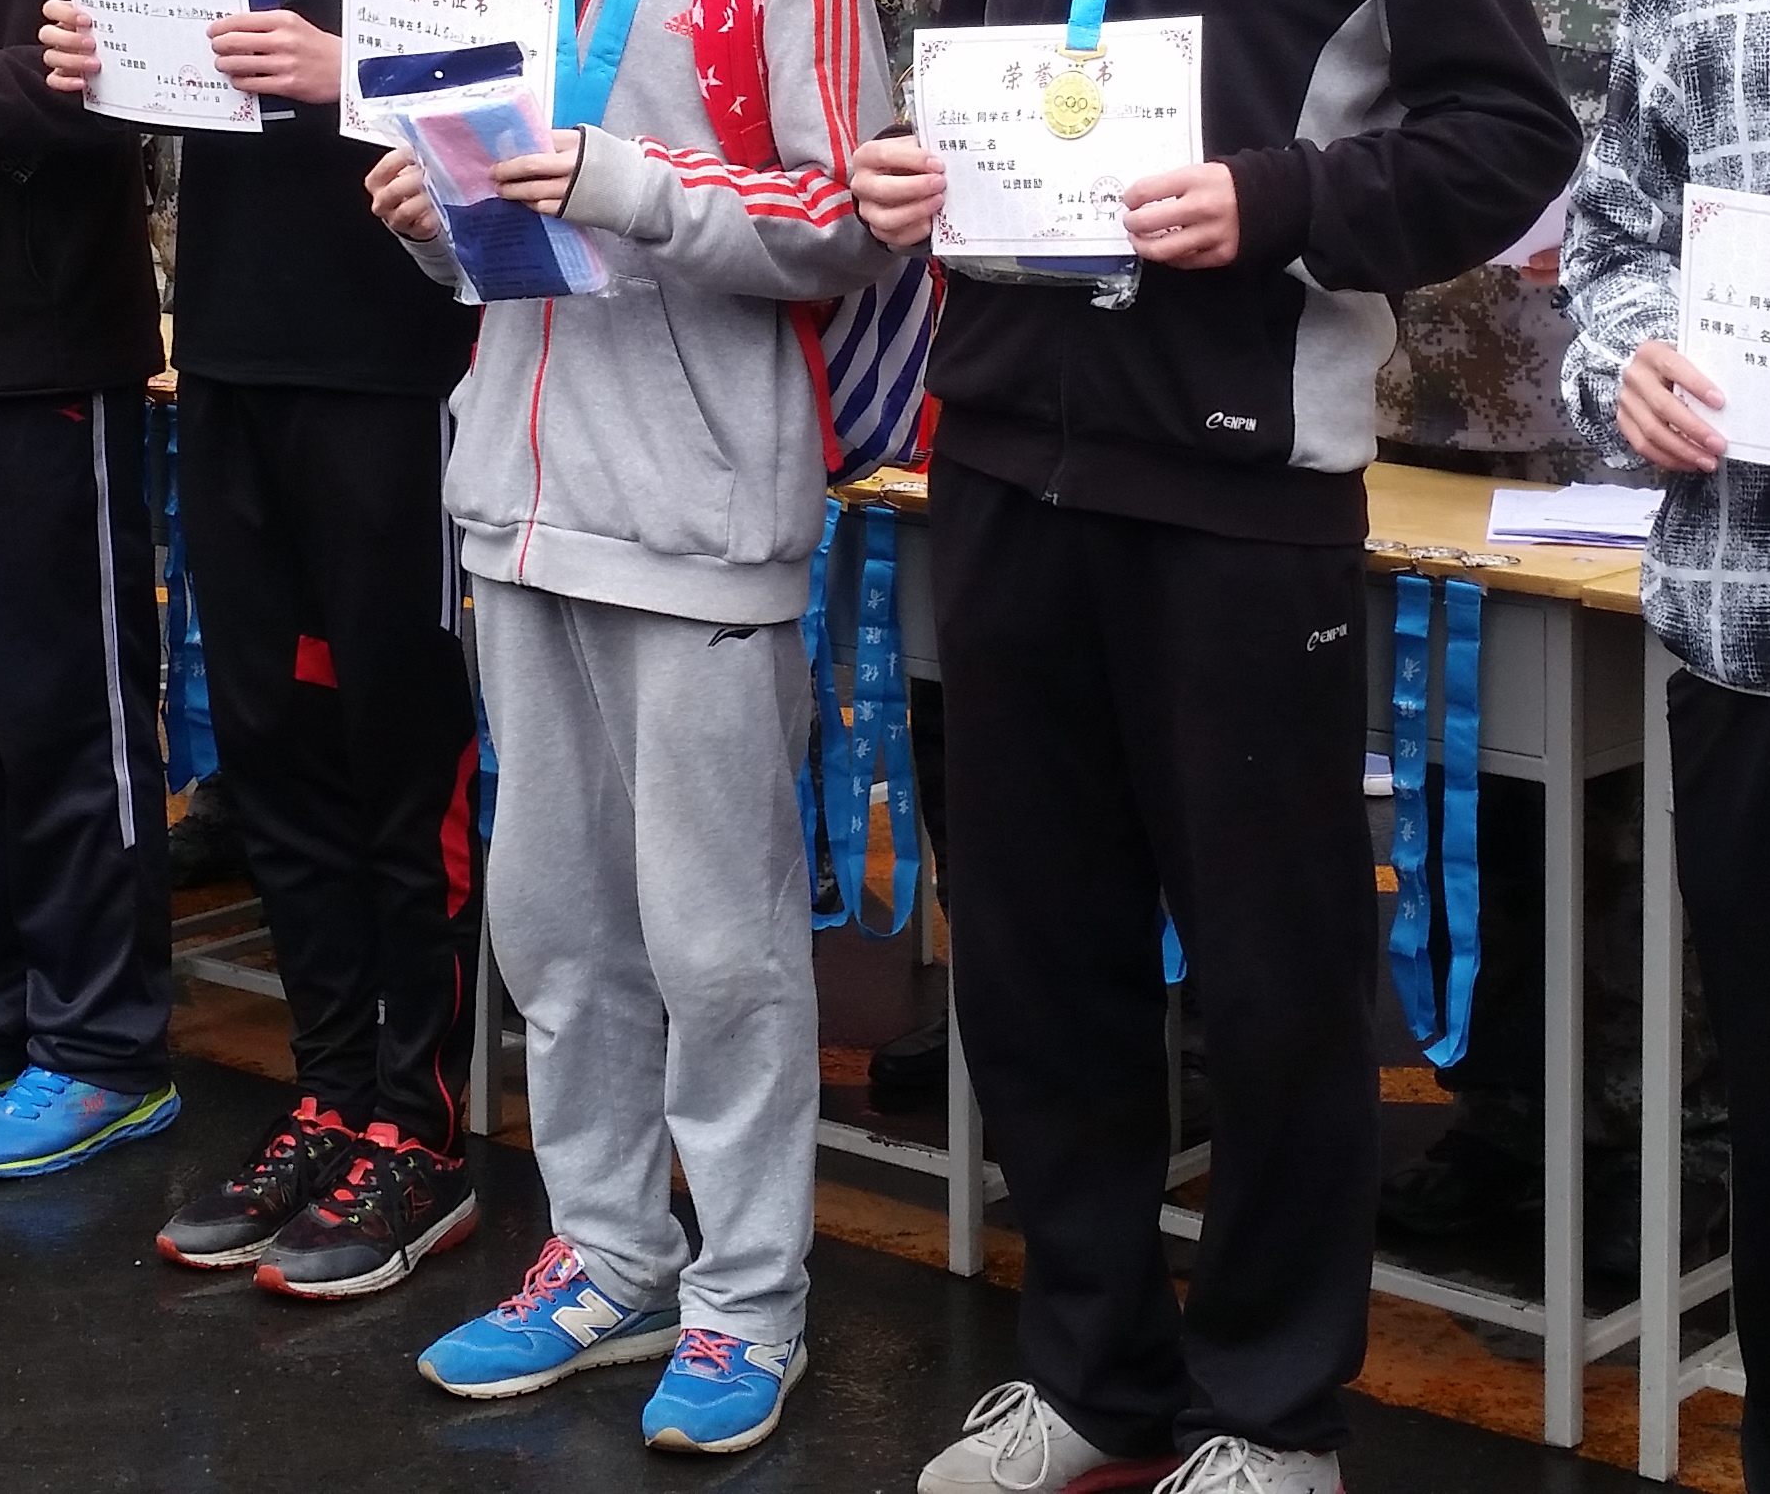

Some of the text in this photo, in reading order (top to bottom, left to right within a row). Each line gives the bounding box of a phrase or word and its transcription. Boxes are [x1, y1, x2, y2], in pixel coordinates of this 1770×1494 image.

[1002, 61, 1114, 90] 荣誉书
[977, 160, 1016, 172] 特发此证
[1002, 178, 1043, 190] 以资鼓励
